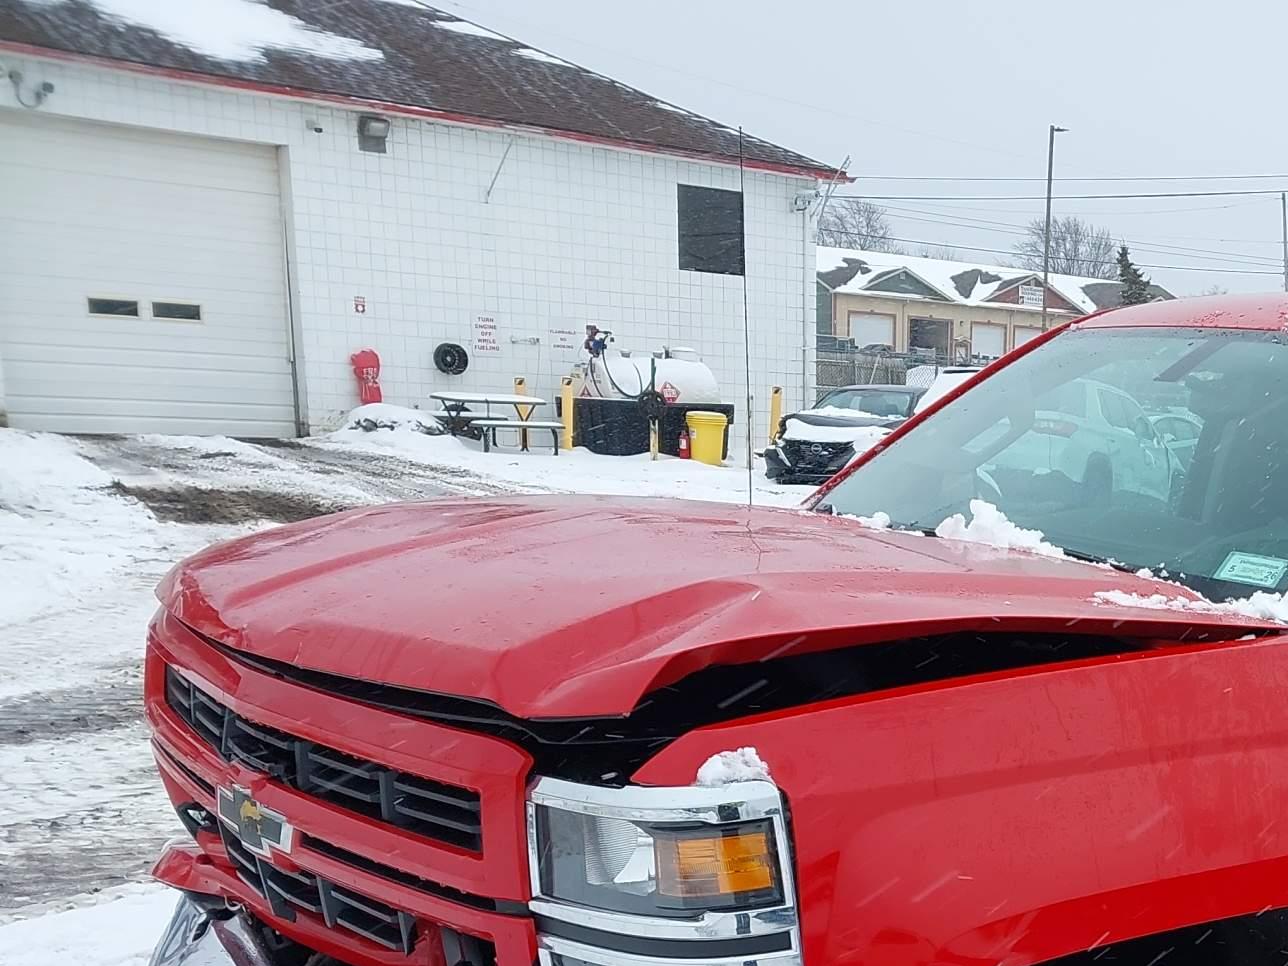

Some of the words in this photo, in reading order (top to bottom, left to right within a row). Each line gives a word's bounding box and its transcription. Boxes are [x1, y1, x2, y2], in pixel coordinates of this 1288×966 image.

[474, 344, 500, 352] FUELING
[1227, 564, 1238, 573] 5
[1264, 571, 1279, 580] 26
